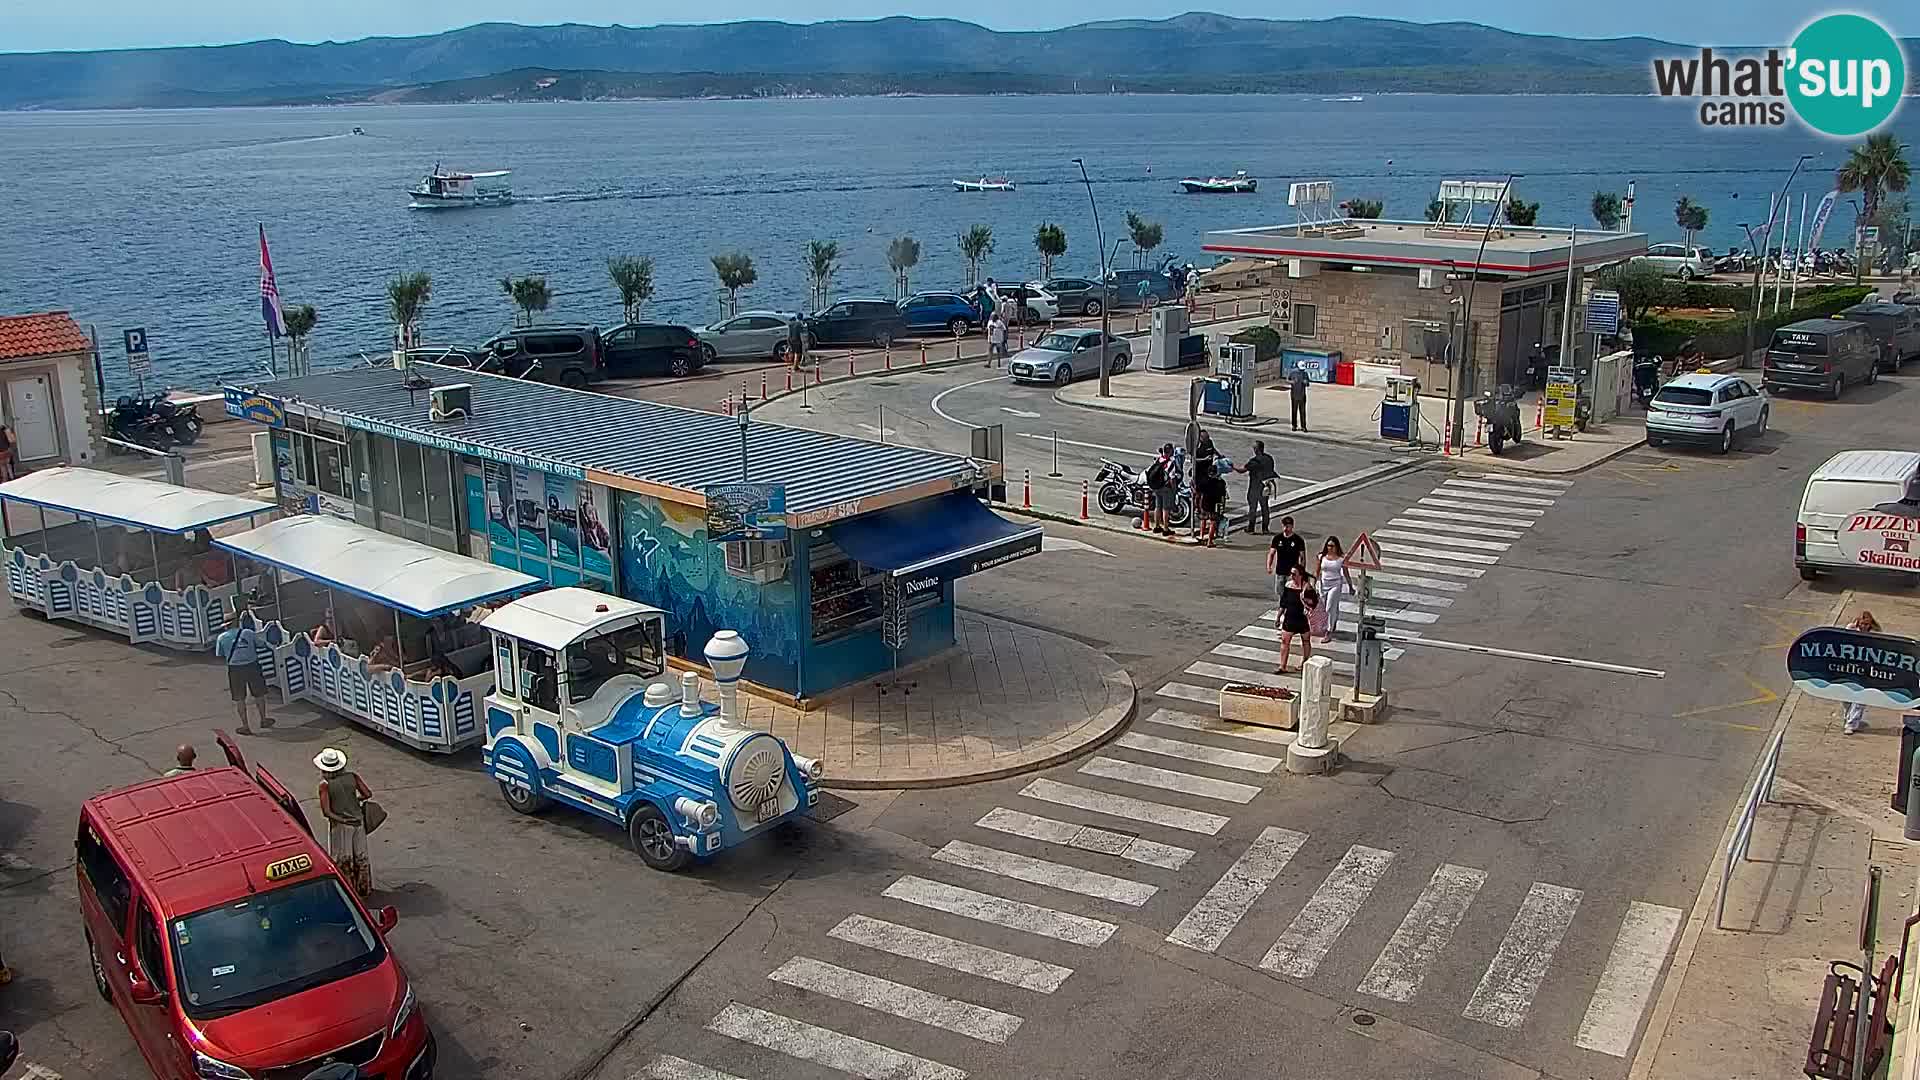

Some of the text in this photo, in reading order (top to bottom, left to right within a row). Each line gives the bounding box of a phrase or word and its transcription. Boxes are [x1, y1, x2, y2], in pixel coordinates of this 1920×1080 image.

[129, 332, 141, 350] P
[395, 427, 435, 446] AUTOBUSNA
[435, 437, 468, 453] POSTAJA
[477, 444, 493, 458] BUS
[493, 448, 526, 466] STATION
[527, 457, 555, 473] TICKET
[554, 463, 582, 478] OFFICE
[1848, 515, 1920, 534] PIZZE
[1881, 530, 1917, 541] GRILL
[1870, 666, 1896, 680] bar
[273, 859, 301, 877] TAXI
